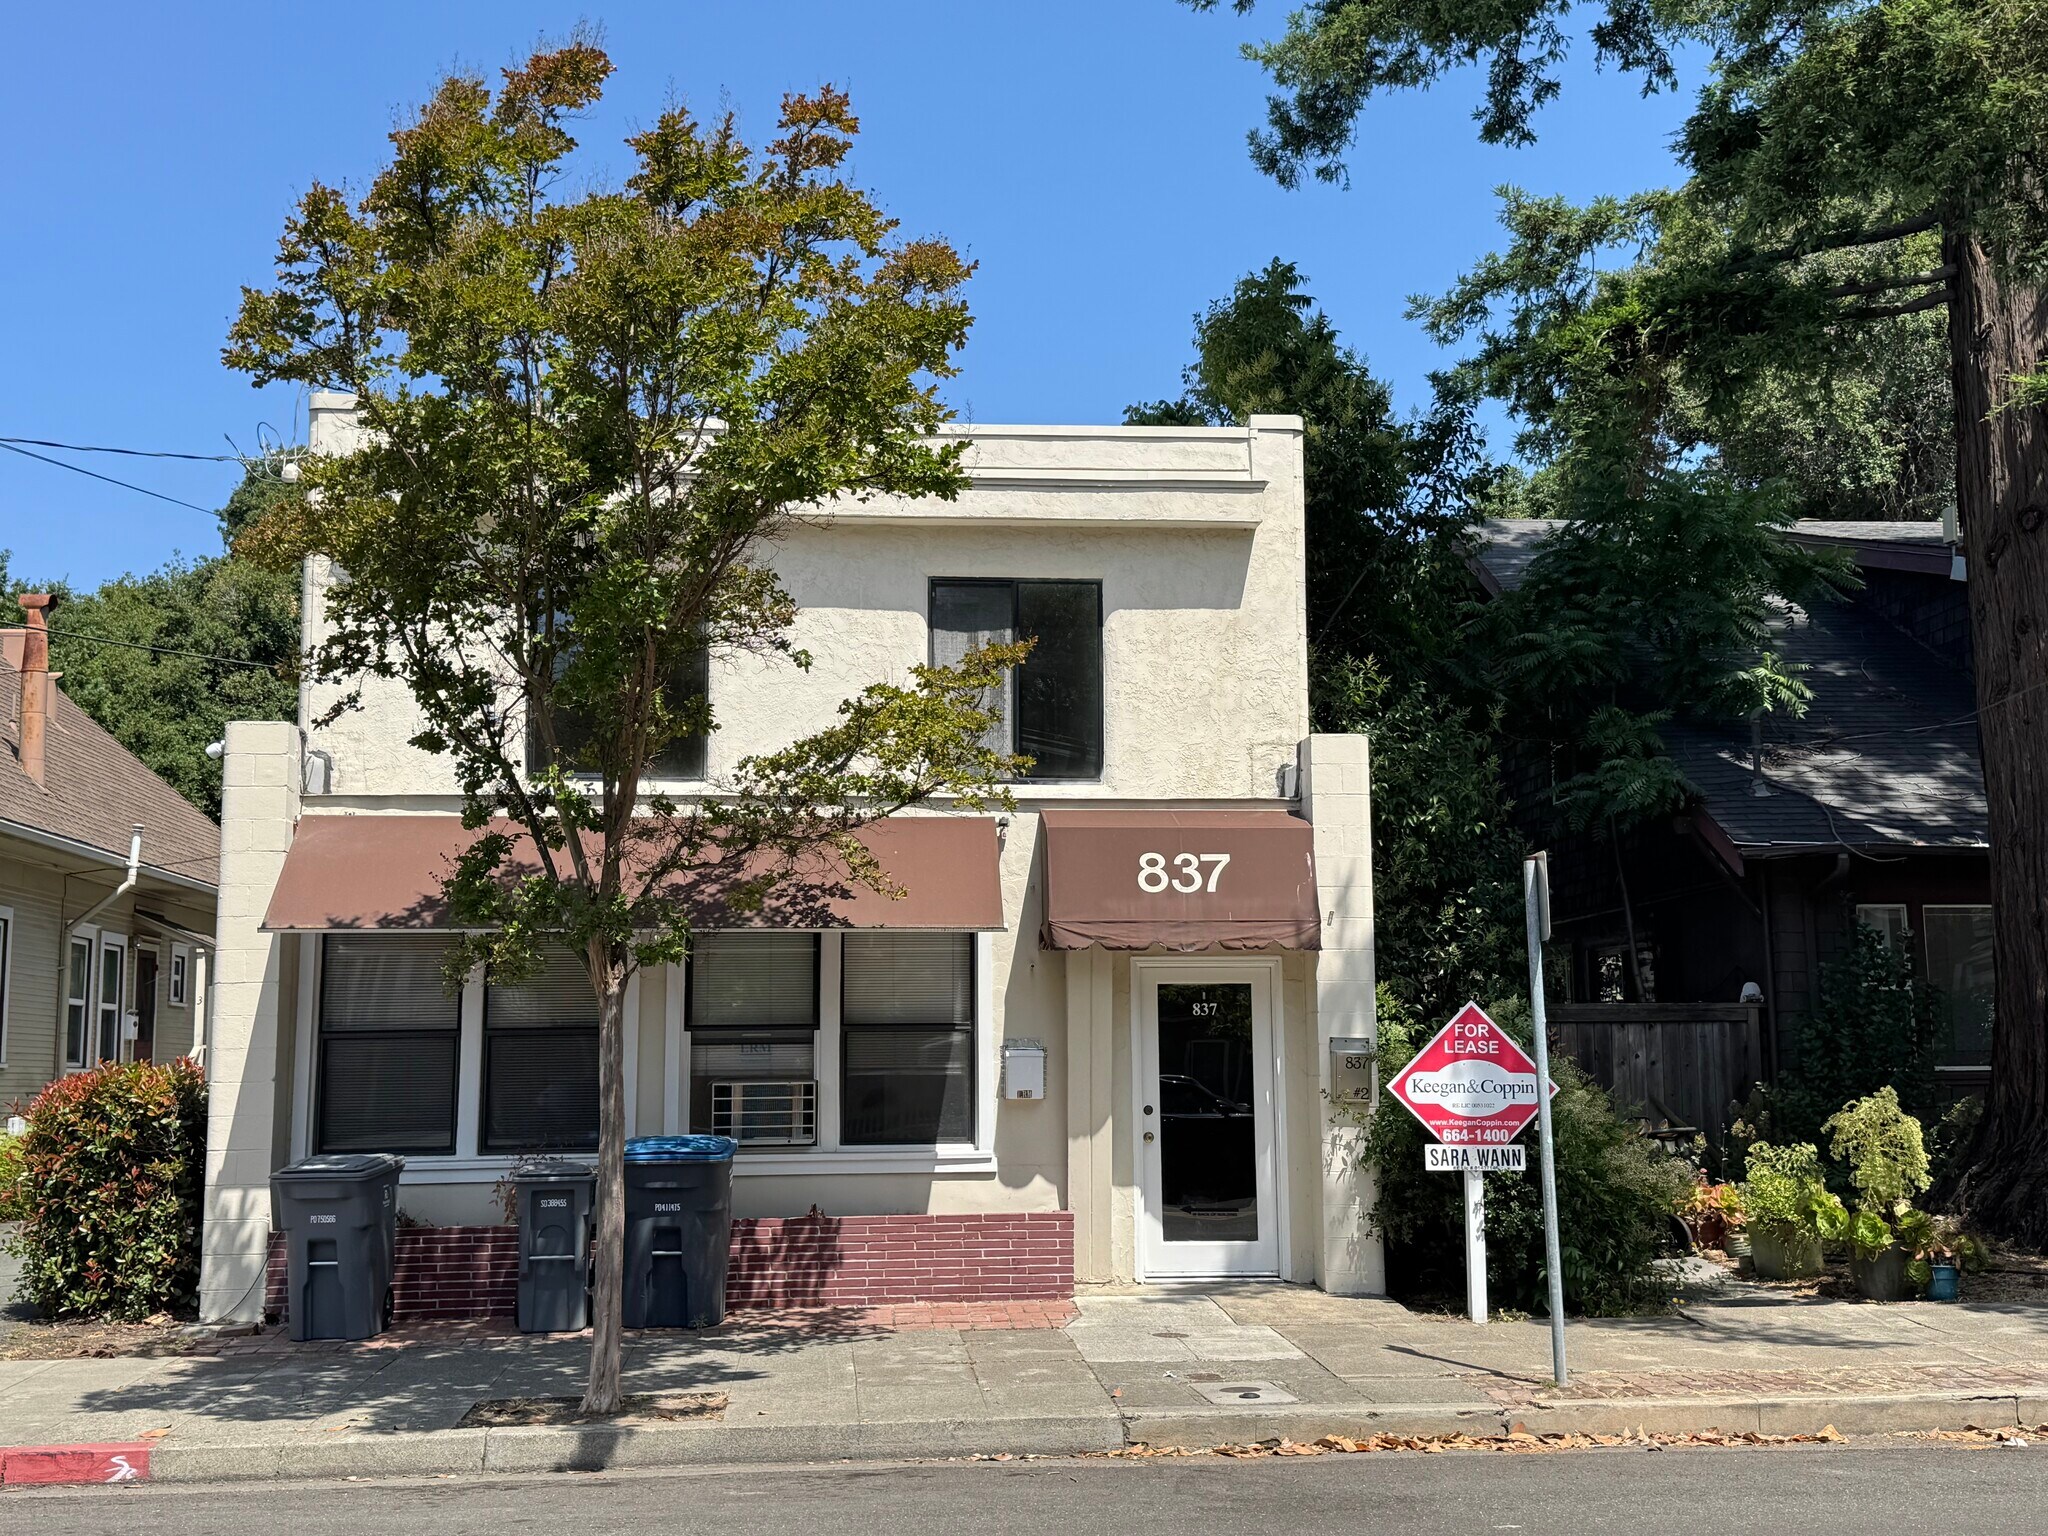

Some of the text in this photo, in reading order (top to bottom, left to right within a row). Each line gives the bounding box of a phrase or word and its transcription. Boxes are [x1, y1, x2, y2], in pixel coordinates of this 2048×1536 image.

[1137, 852, 1231, 893] 837
[1192, 1002, 1218, 1016] 837
[1454, 1023, 1490, 1038] FOR
[1443, 1040, 1500, 1054] LEASE
[1345, 1056, 1370, 1070] 837
[1353, 1087, 1370, 1100] #2
[1411, 1078, 1535, 1100] Keegan&Coppin
[1429, 1118, 1520, 1127] www.KeeganCoppin.com
[1442, 1128, 1509, 1142] 664-1400
[1430, 1148, 1521, 1167] SARA WANN
